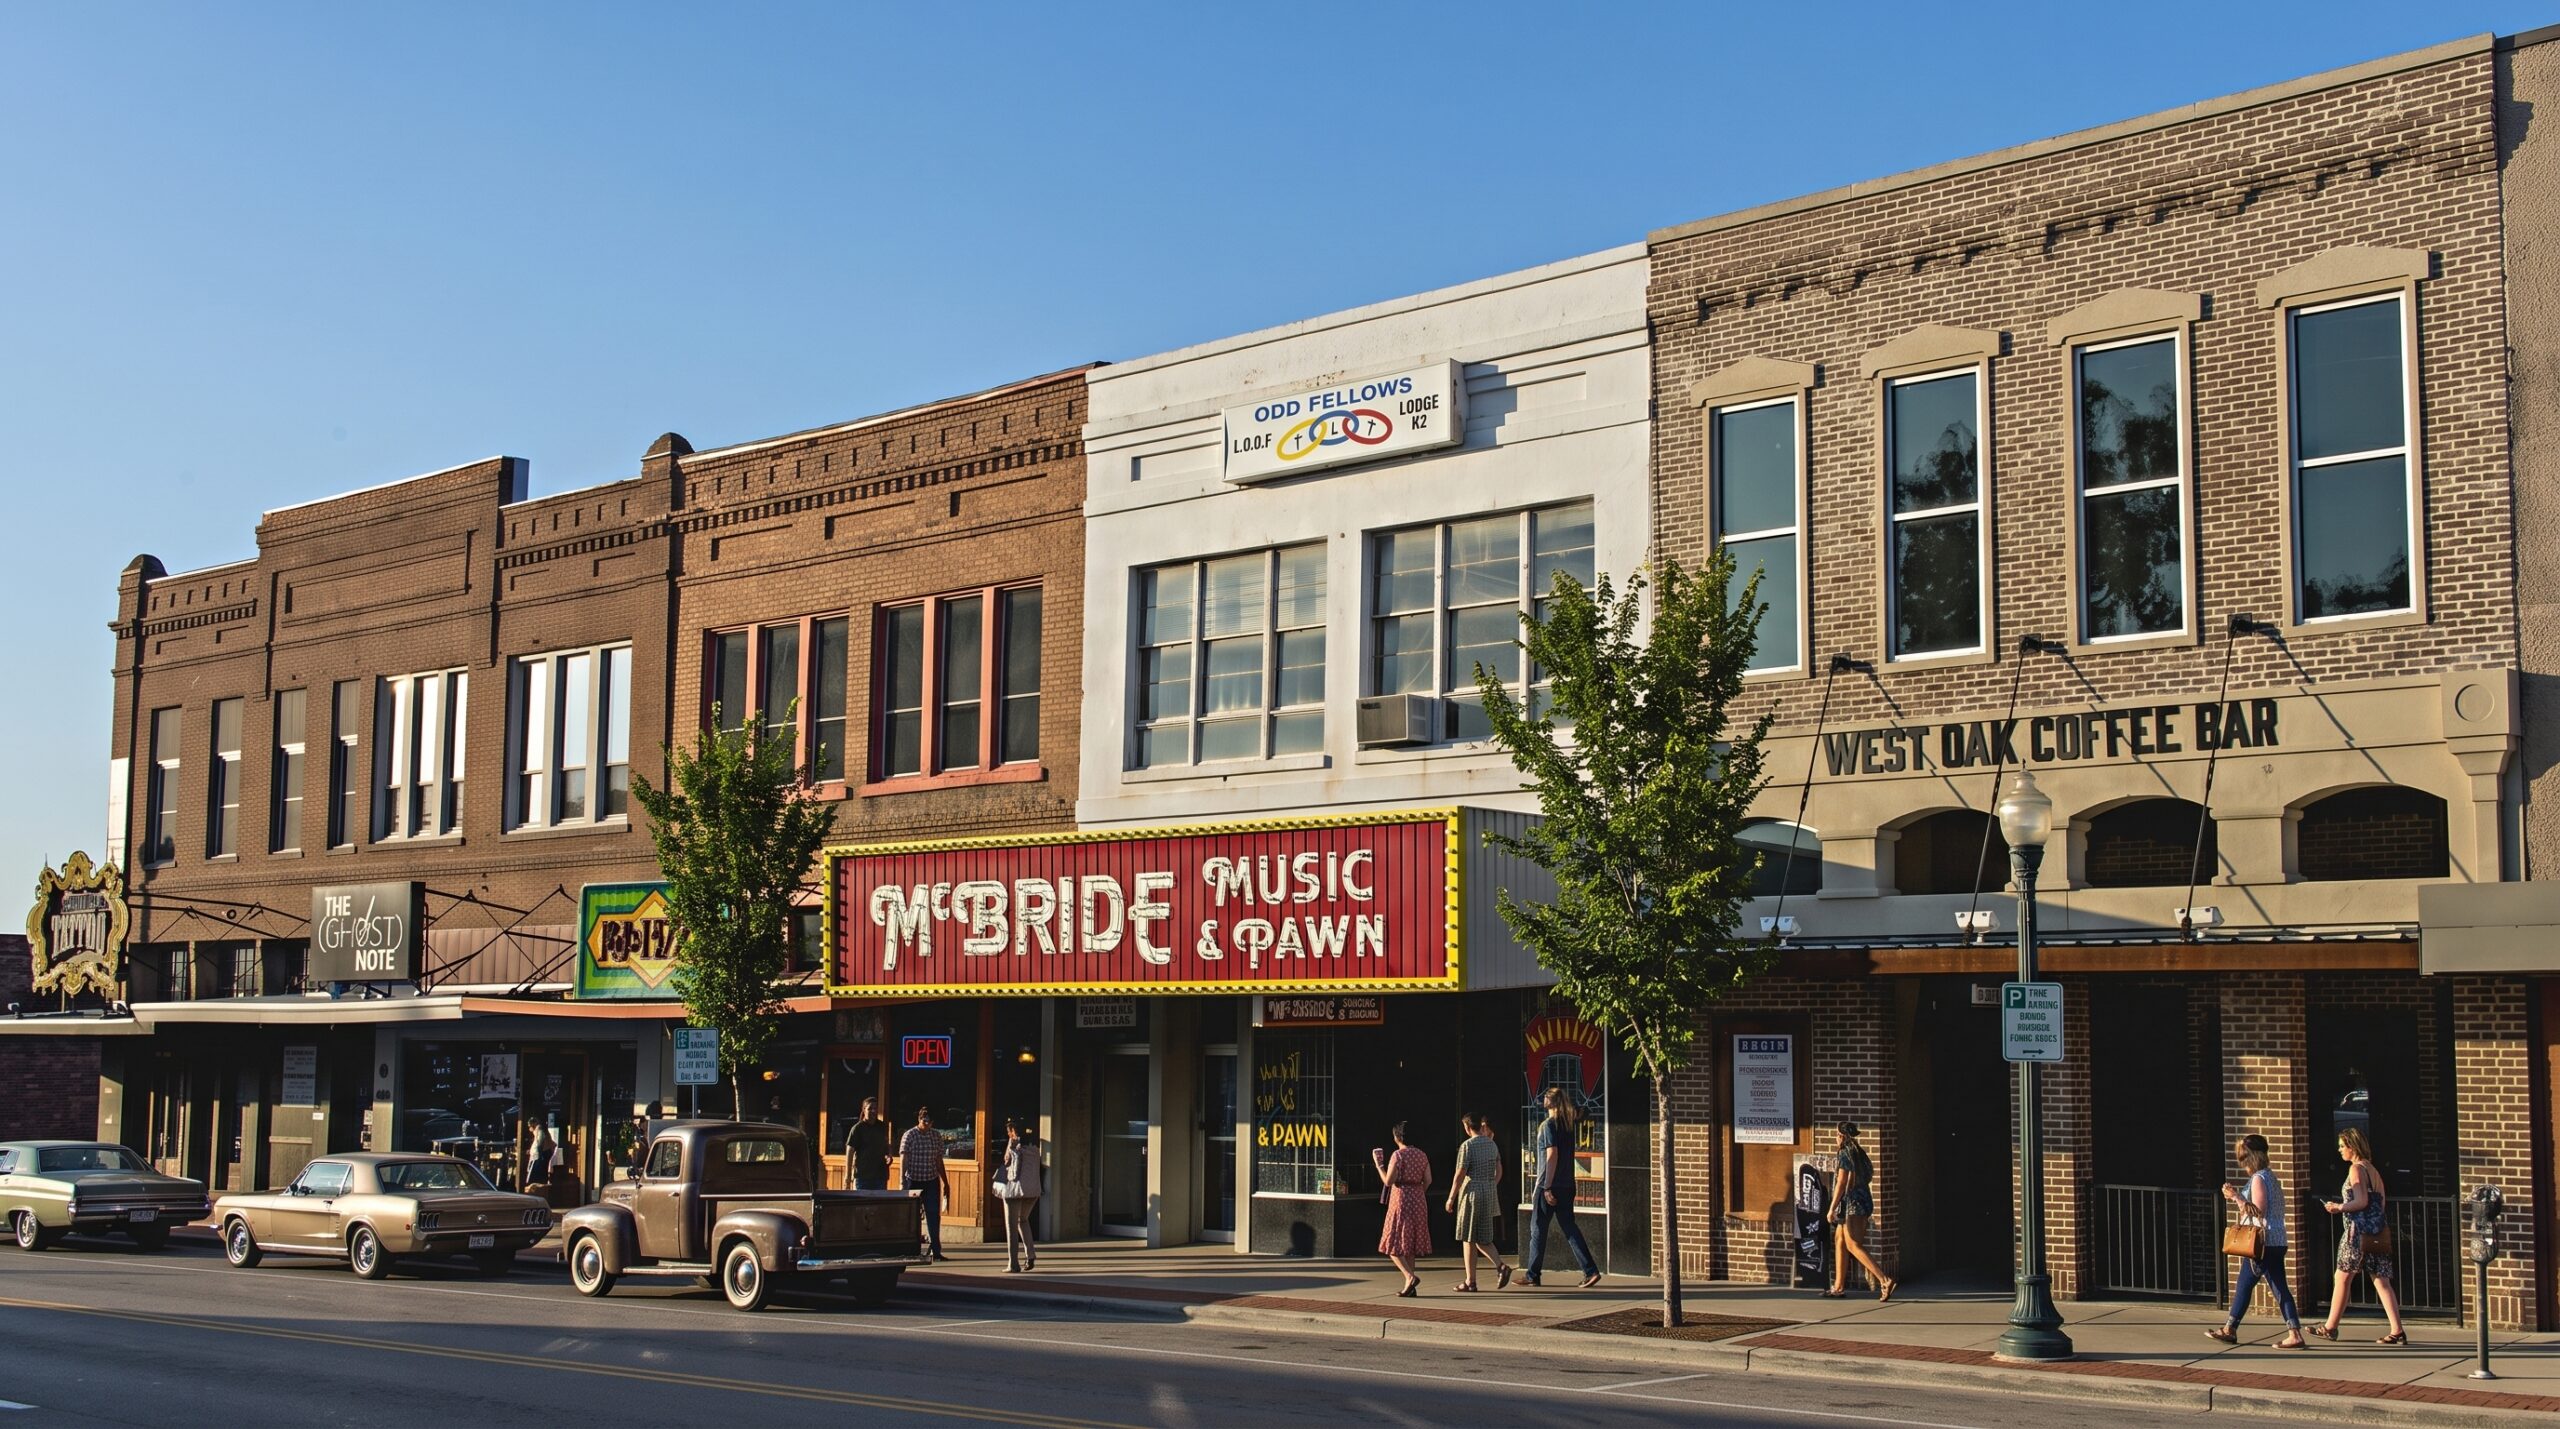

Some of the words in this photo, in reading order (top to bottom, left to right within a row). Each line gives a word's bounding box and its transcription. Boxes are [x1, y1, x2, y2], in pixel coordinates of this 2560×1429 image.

[1254, 400, 1300, 423] ODD
[1309, 376, 1413, 412] FELLOWS
[1399, 394, 1439, 416] LODGE
[1411, 414, 1427, 430] K2
[1233, 433, 1272, 454] L.O.O.F
[1822, 726, 1930, 776] WEST
[1941, 718, 2019, 768] OAK
[2031, 707, 2183, 762] COFFEE
[2195, 697, 2280, 751] BAR
[1202, 848, 1374, 907] MUSIC
[324, 895, 351, 917] THE
[1196, 919, 1224, 960] &
[1232, 912, 1385, 969] PAWN
[355, 949, 395, 972] NOTE
[2009, 989, 2022, 1007] P
[905, 1039, 949, 1065] OPEN
[1258, 1126, 1270, 1147] &
[1272, 1122, 1328, 1148] PAWN
